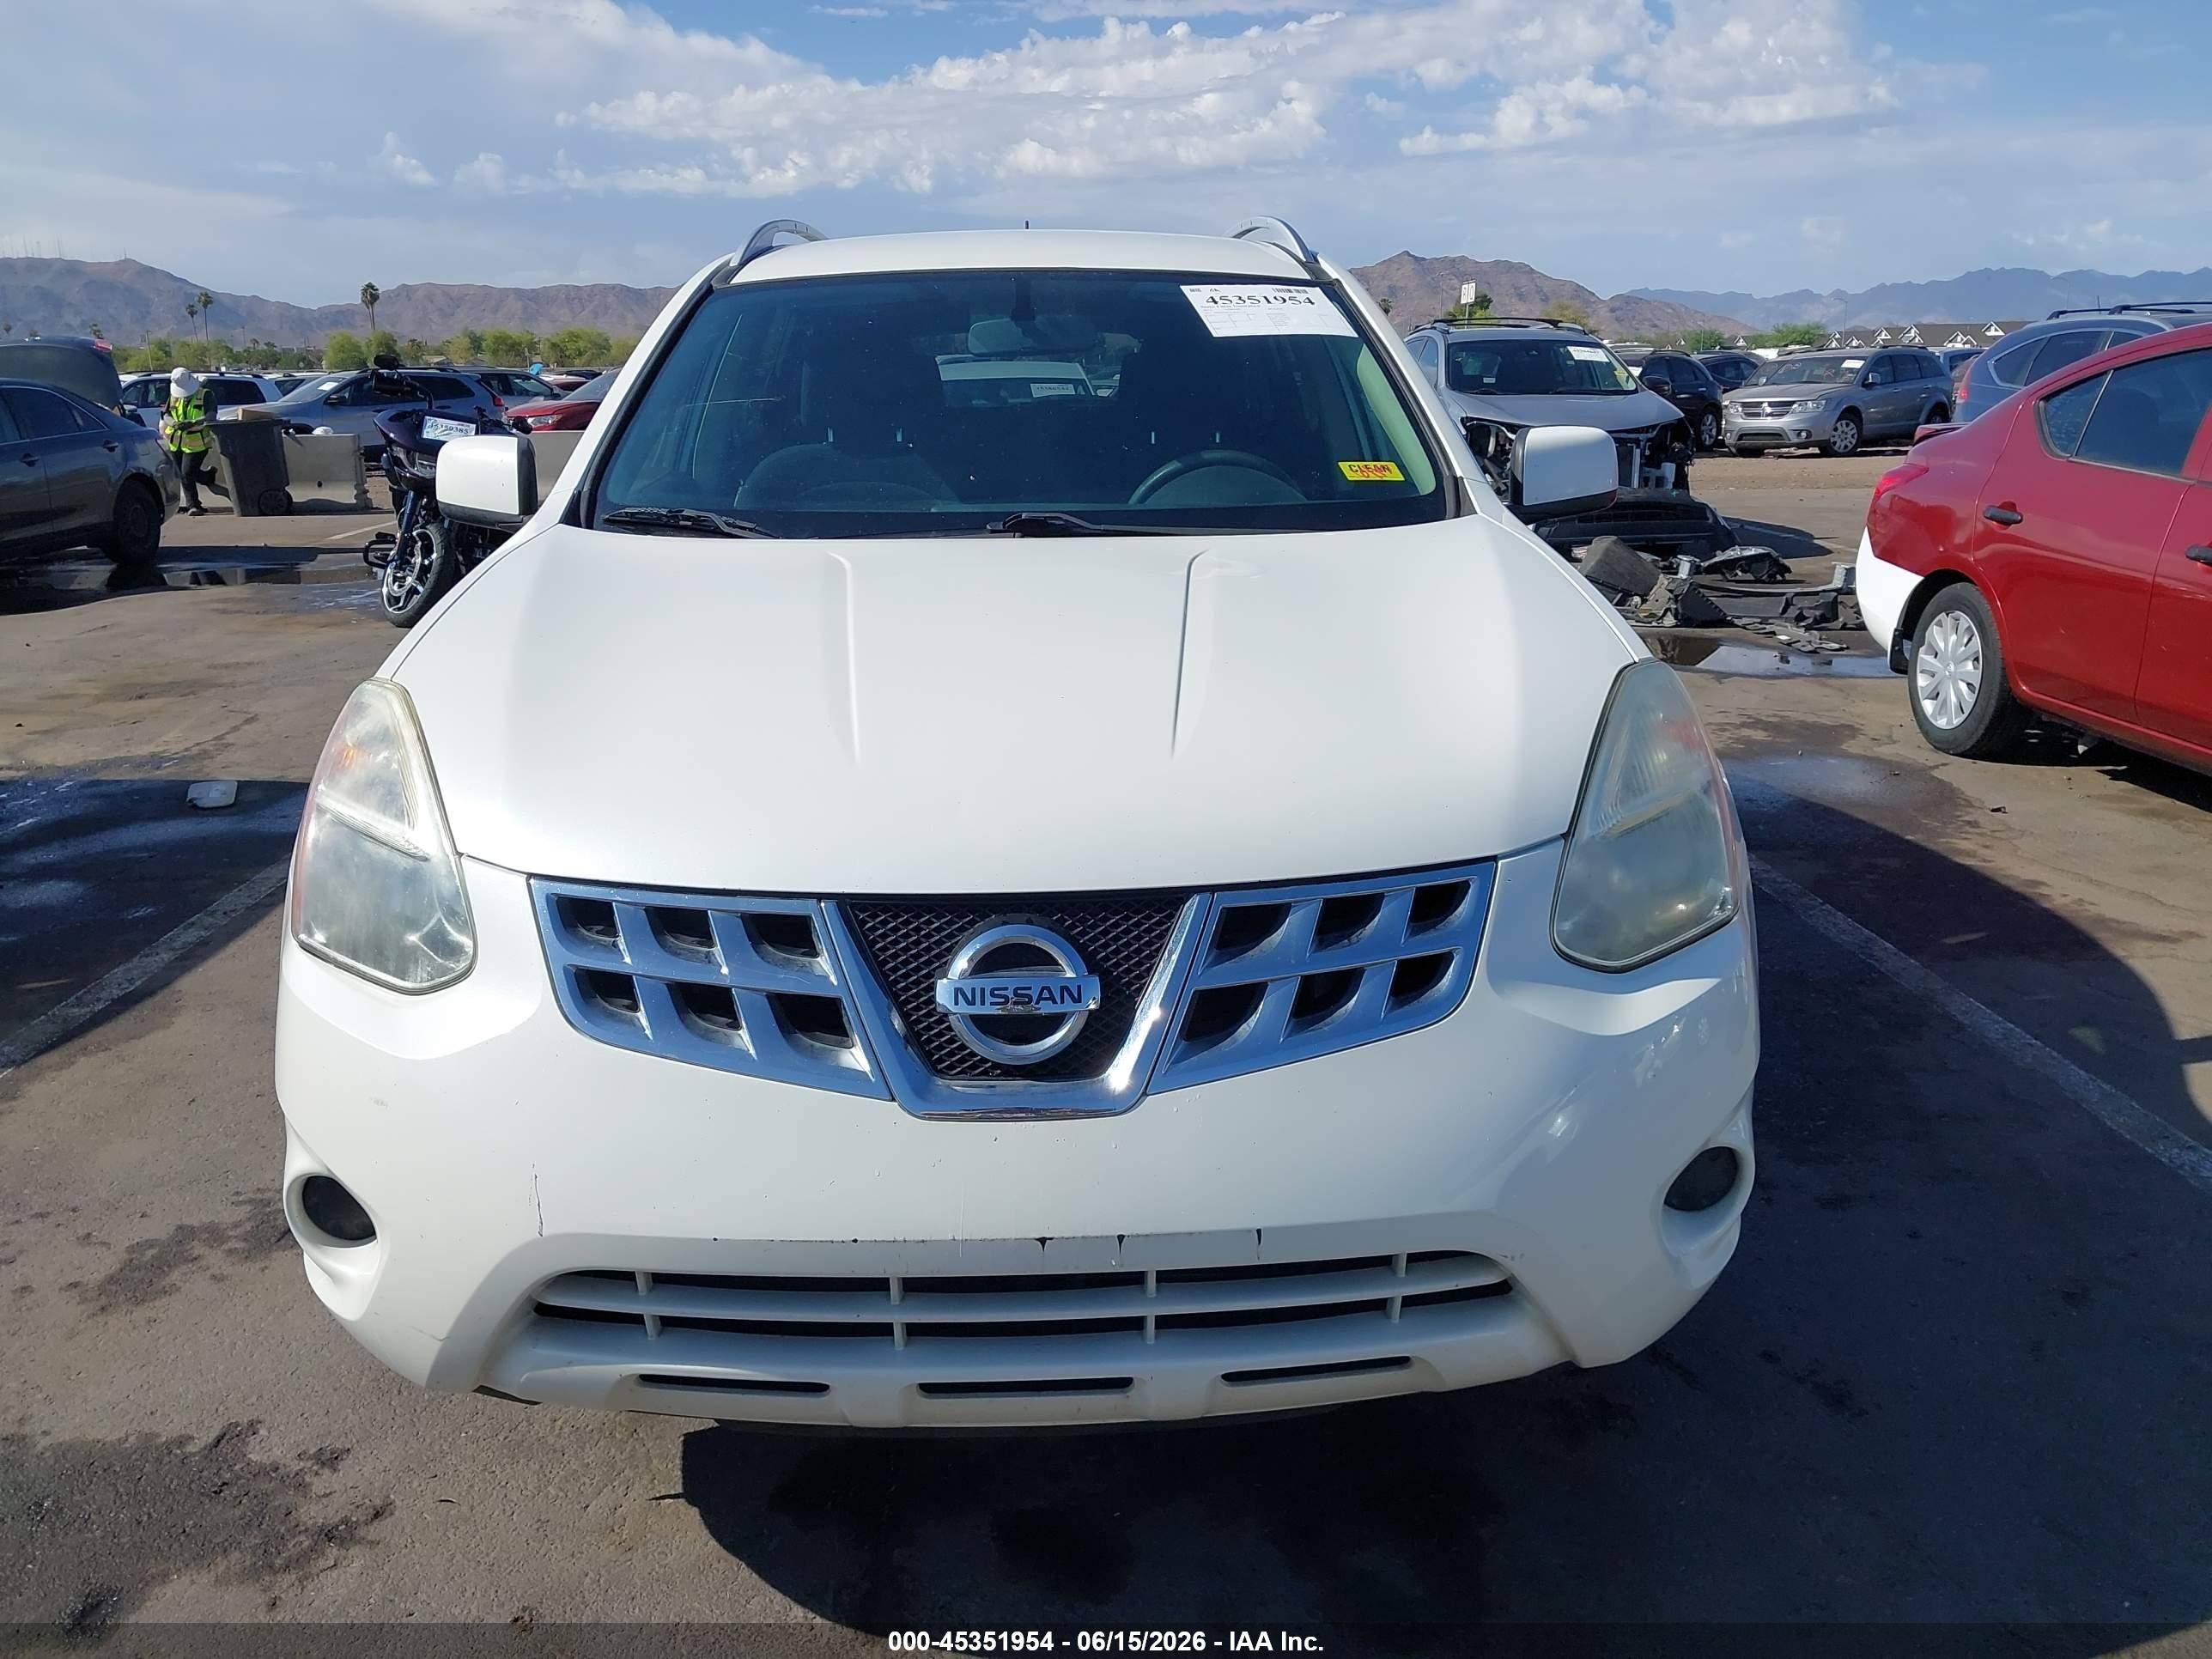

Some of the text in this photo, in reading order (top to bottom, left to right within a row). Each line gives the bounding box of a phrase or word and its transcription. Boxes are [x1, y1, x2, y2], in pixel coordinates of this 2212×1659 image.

[1206, 295, 1316, 306] 45351954
[1348, 464, 1392, 473] CLEAN
[954, 985, 1082, 1006] NISSAN
